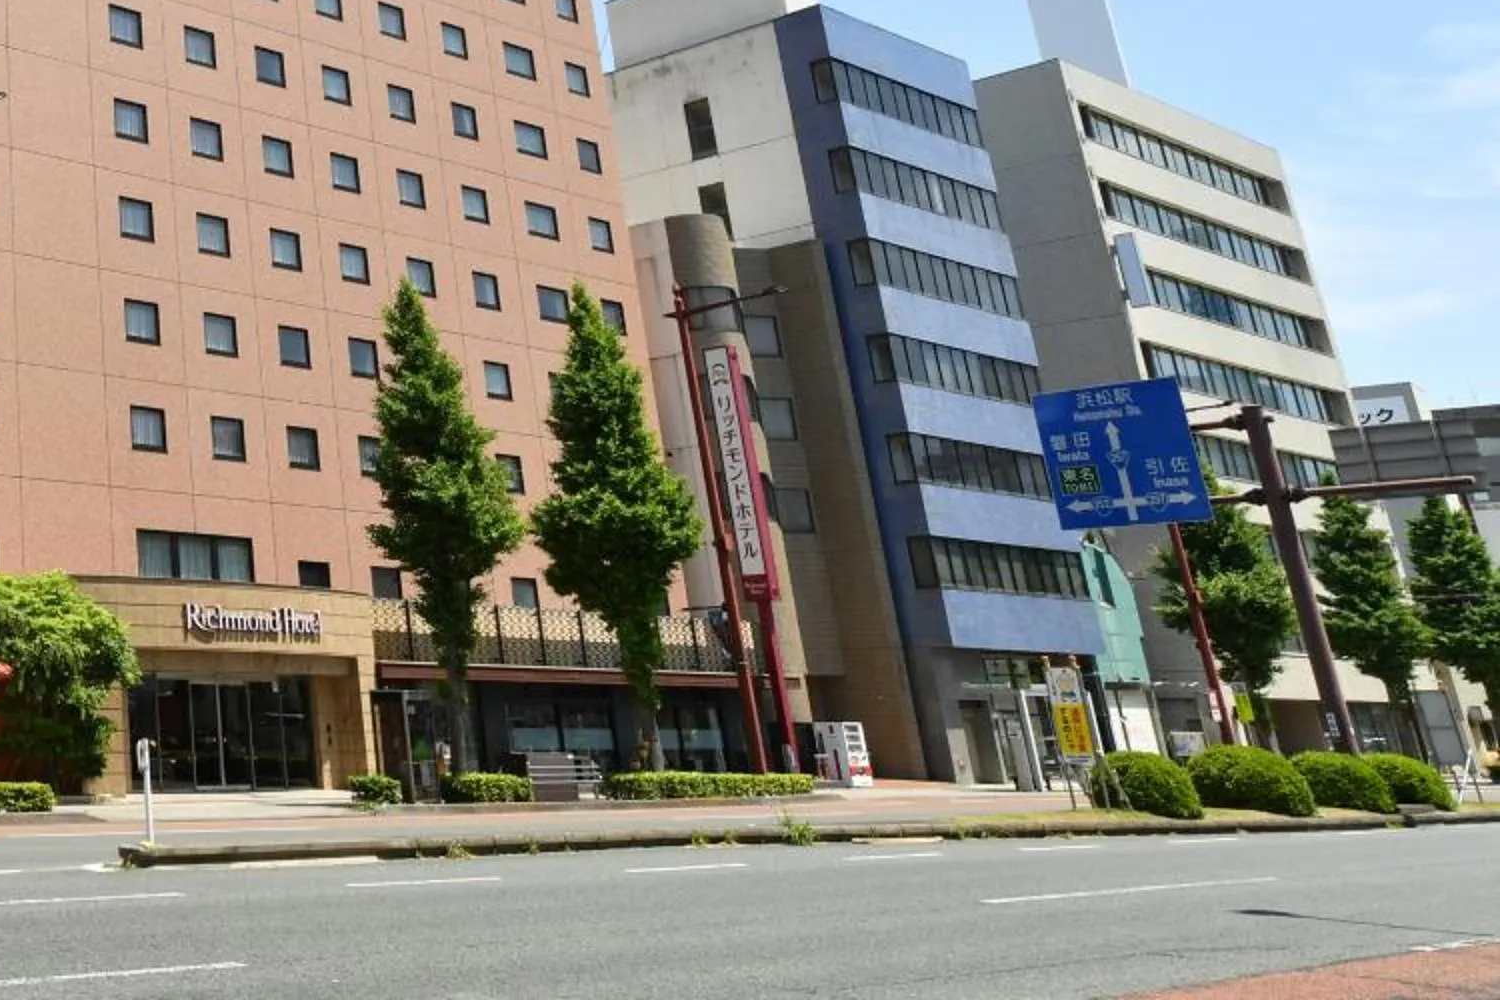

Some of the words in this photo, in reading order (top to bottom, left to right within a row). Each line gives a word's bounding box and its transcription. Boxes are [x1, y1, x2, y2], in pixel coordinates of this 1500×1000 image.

[1075, 387, 1133, 409] 浜松駅
[715, 396, 759, 560] リッチモンドホテル
[185, 603, 281, 633] Richmond
[283, 607, 323, 634] Hotel
